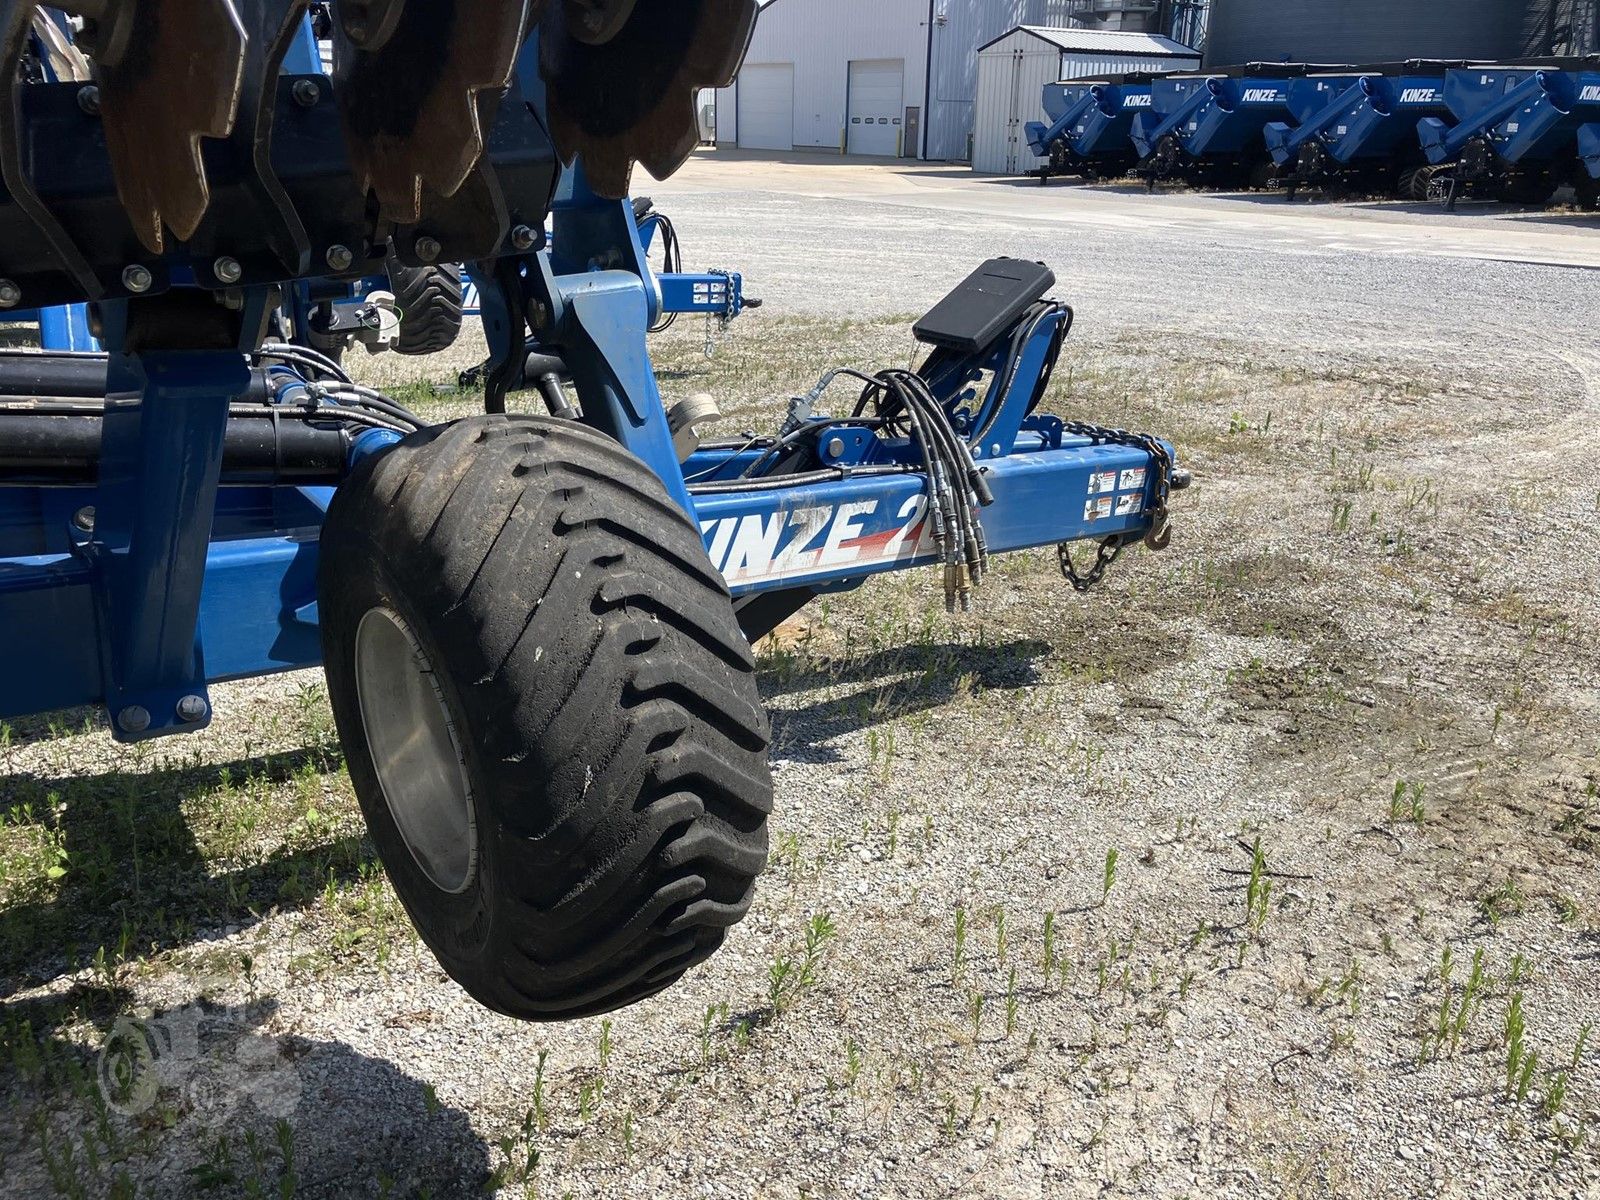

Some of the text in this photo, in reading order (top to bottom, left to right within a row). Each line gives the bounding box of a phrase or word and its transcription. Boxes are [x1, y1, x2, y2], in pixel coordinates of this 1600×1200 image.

[1242, 88, 1278, 102] KINZE
[1399, 88, 1436, 102] KINZE
[1579, 85, 1600, 100] KIN
[699, 499, 878, 582] INZE
